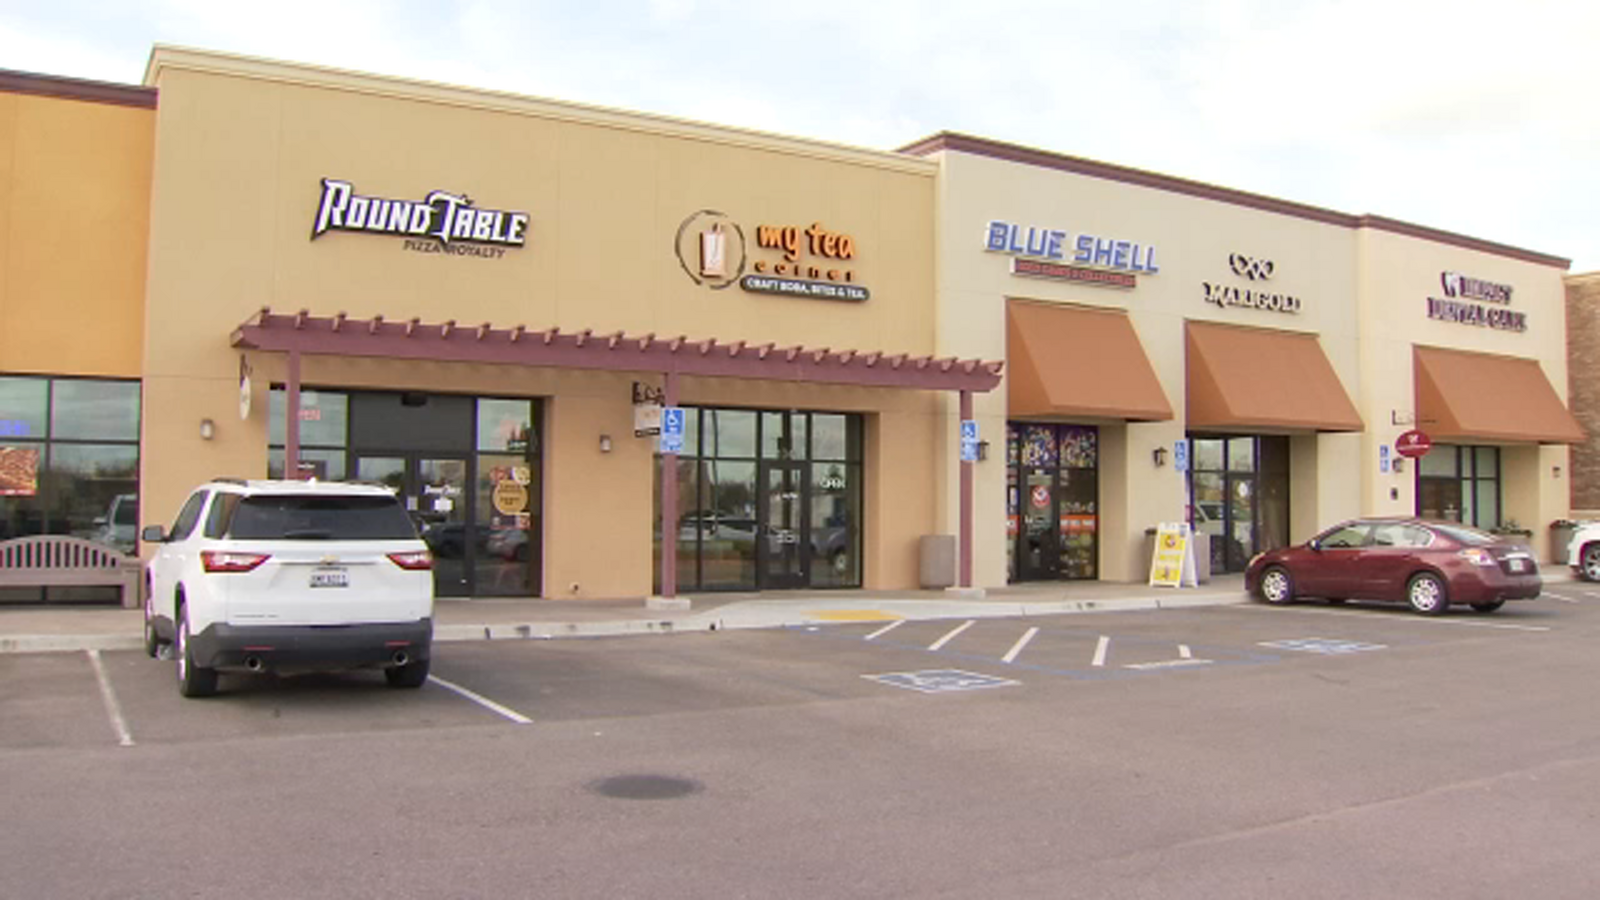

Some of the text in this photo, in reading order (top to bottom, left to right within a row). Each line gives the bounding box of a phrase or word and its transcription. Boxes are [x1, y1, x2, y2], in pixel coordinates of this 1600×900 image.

[311, 178, 529, 247] ROUND TABLE
[403, 239, 505, 259] PIZZA ROYALTY
[756, 221, 855, 262] my tea
[984, 220, 1160, 274] BLUE SHELL
[746, 278, 779, 291] CRAFT
[1202, 281, 1302, 314] MARIGOLD
